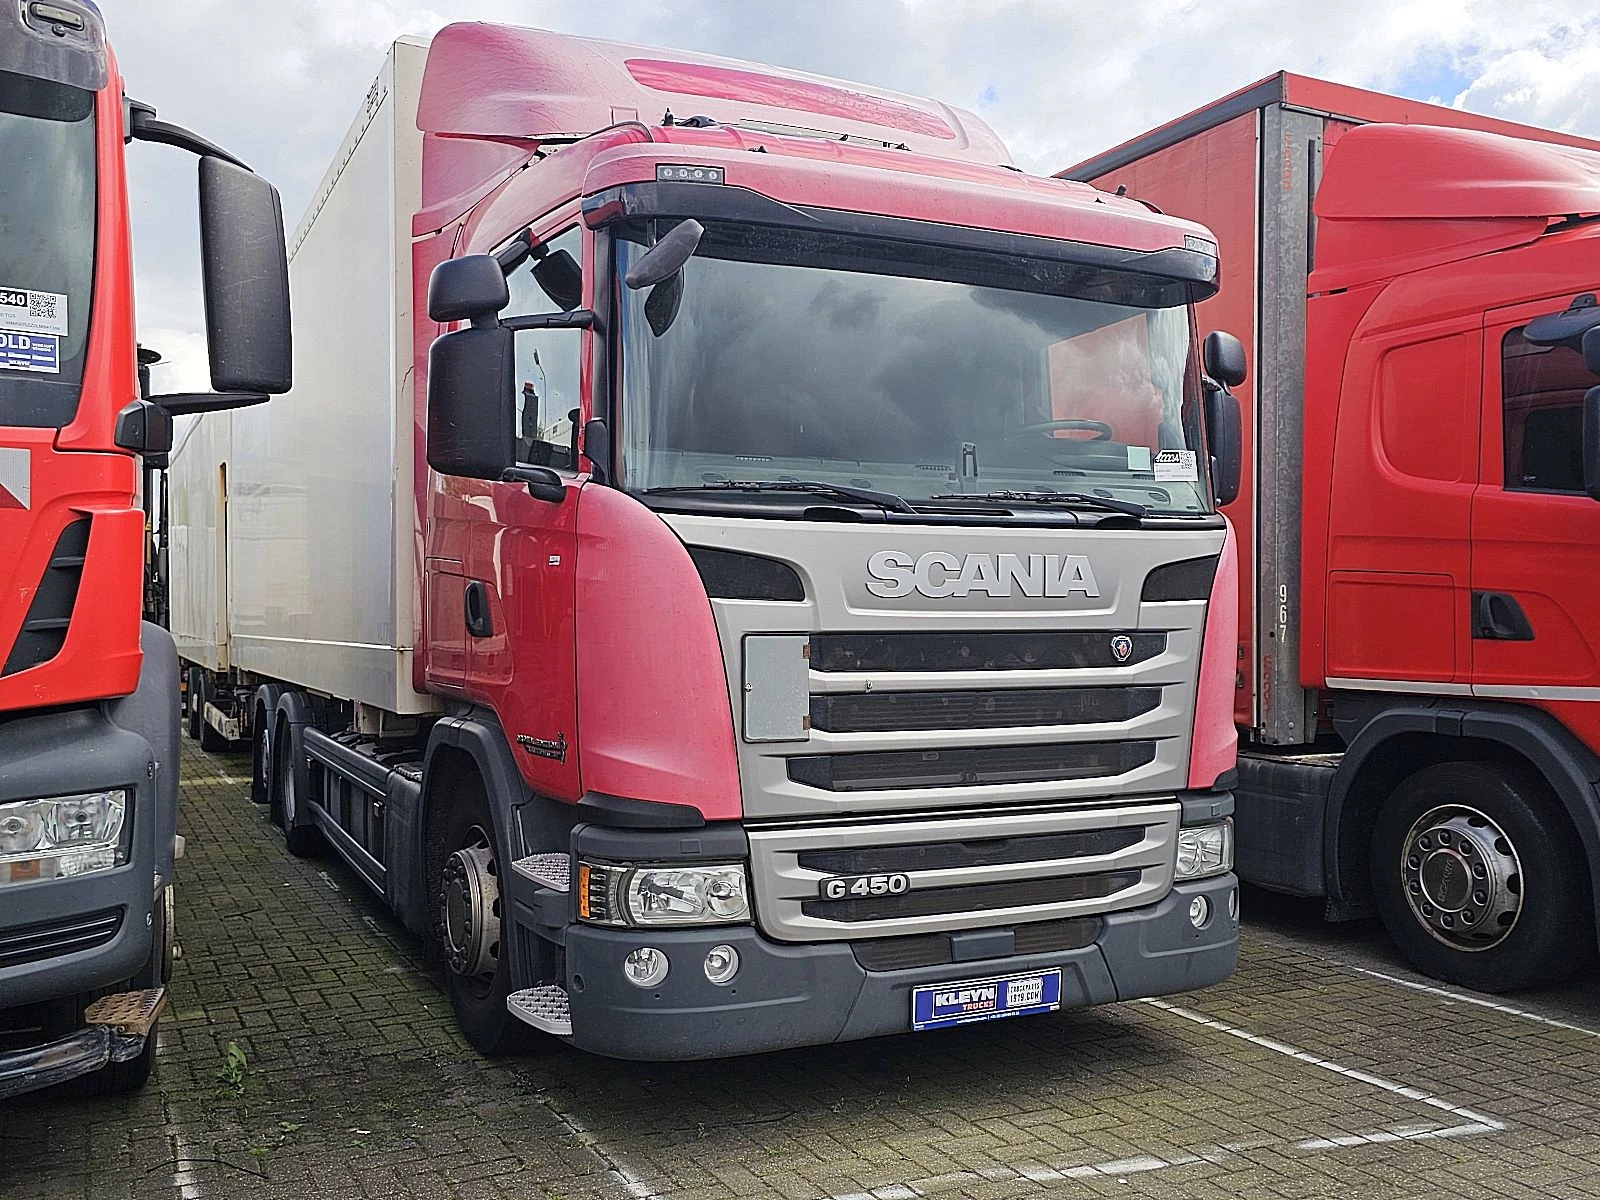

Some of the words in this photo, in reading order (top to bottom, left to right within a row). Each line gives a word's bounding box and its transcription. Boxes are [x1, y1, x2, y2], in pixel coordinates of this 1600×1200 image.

[0, 292, 25, 306] 540
[865, 550, 1100, 599] SCANIA
[1279, 584, 1288, 643] 967
[826, 880, 846, 899] G
[850, 874, 907, 896] 450
[935, 987, 995, 1007] KLEYN
[962, 1000, 995, 1011] TRUCKS
